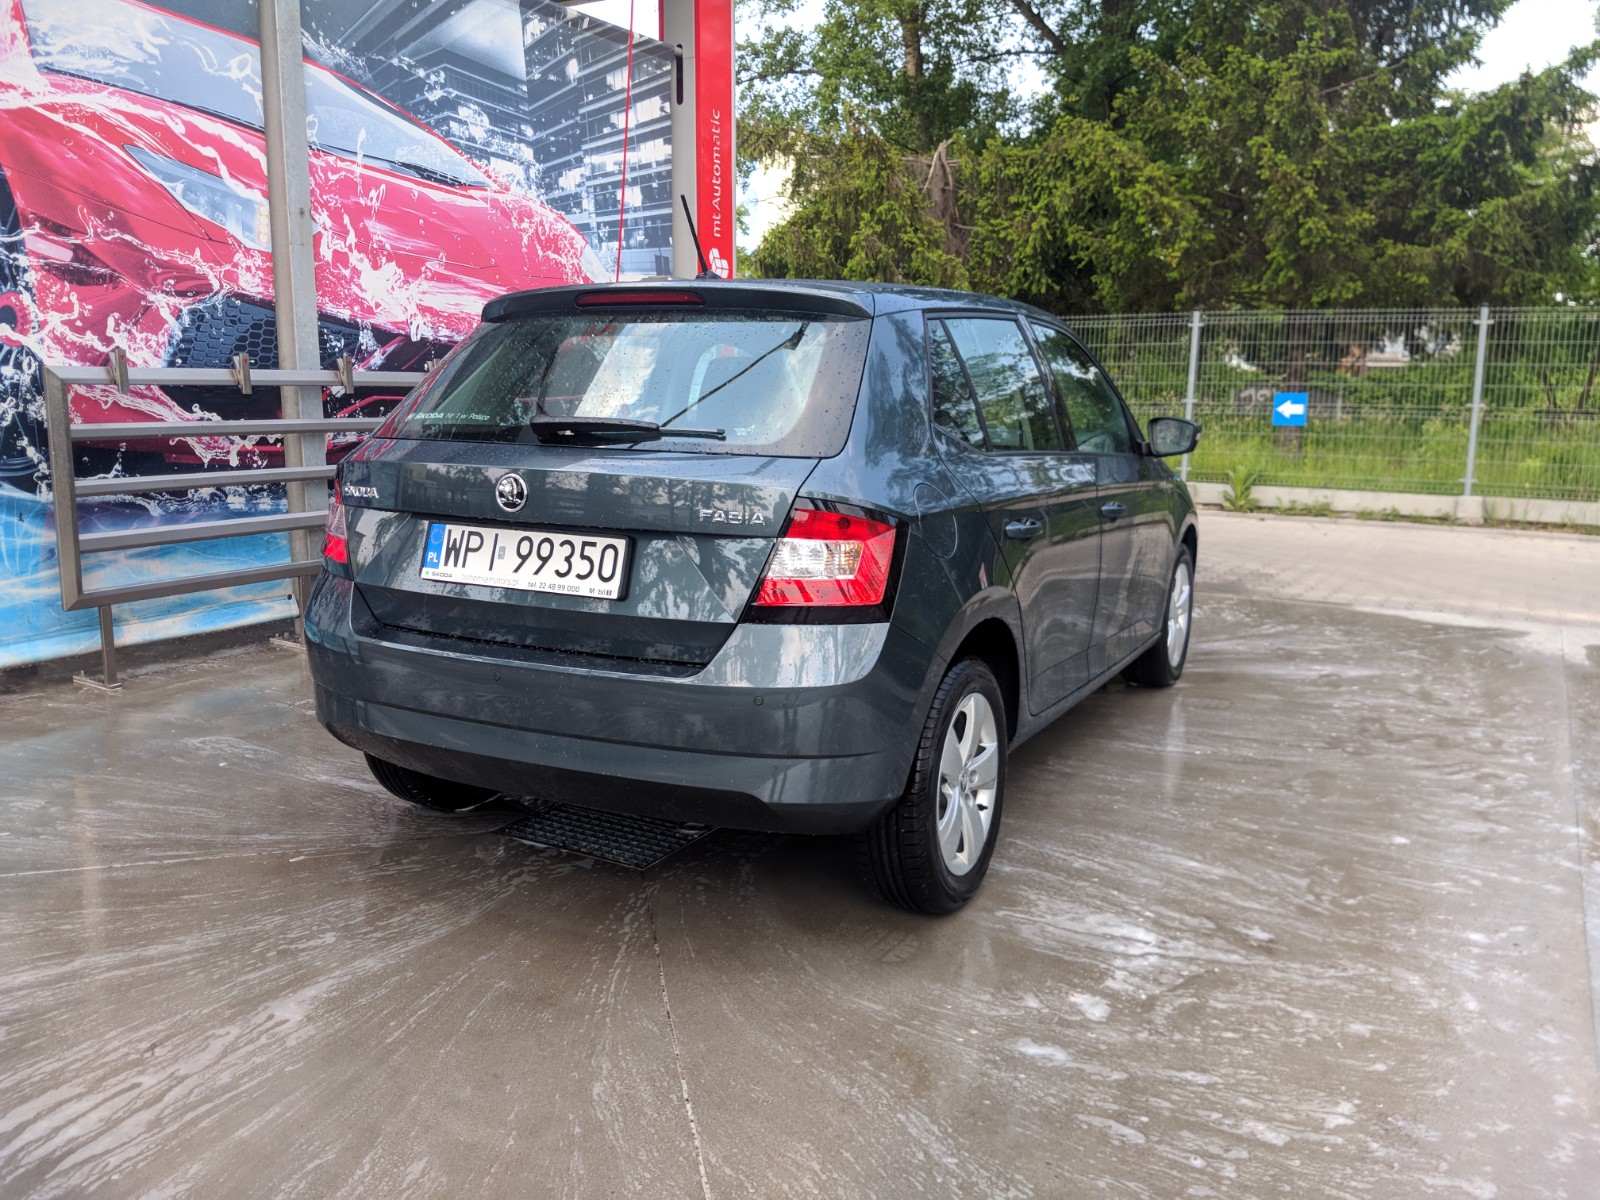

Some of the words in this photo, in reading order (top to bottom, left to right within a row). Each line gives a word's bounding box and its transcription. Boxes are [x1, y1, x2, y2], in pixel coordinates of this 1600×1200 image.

[712, 108, 721, 238] mtAutomatic
[699, 509, 766, 526] FABIA
[427, 551, 439, 563] PL
[512, 535, 619, 583] 99350
[547, 583, 556, 591] 48
[557, 584, 566, 592] 99
[566, 585, 580, 593] 000
